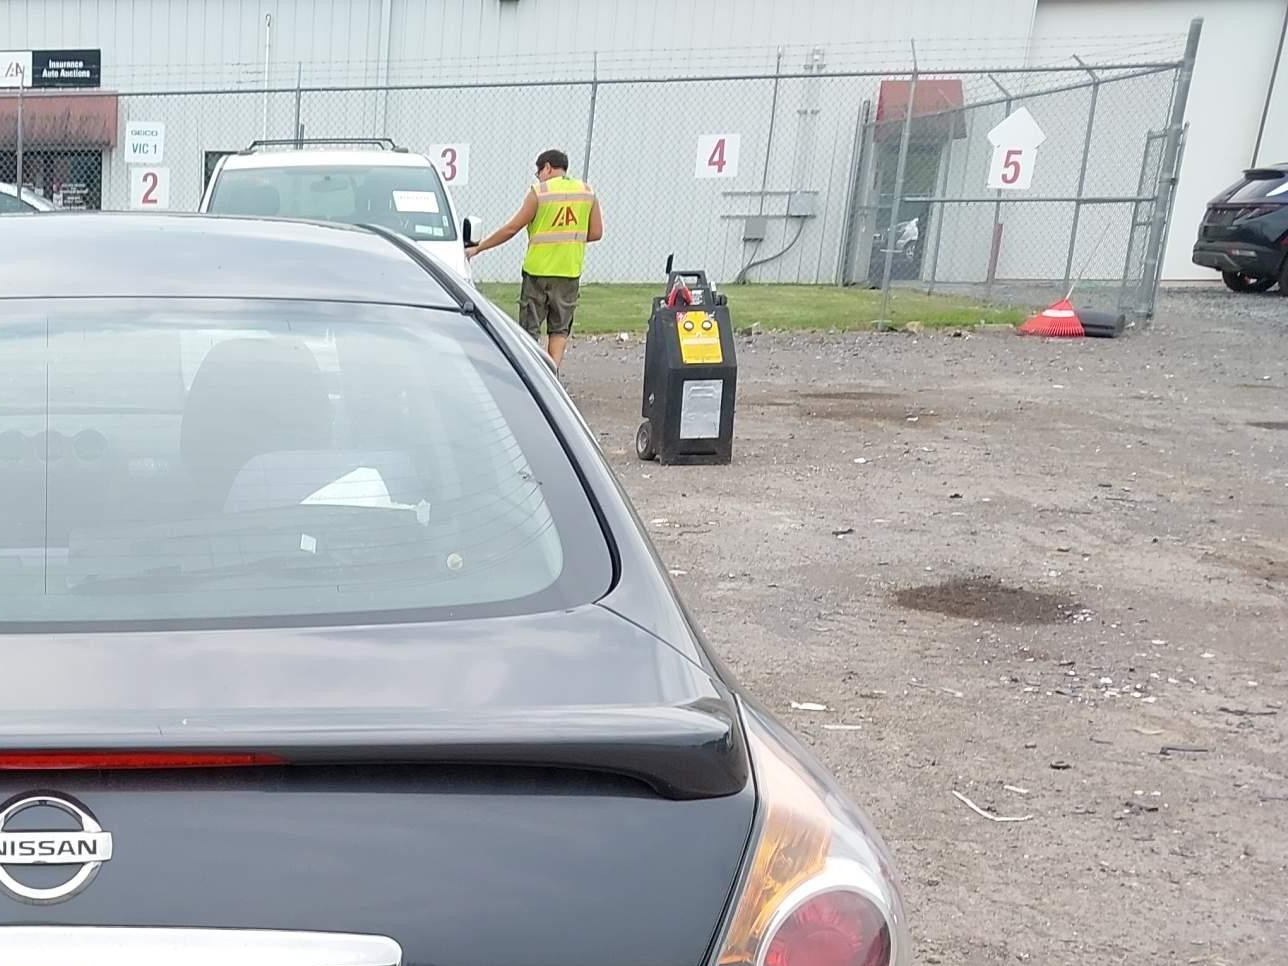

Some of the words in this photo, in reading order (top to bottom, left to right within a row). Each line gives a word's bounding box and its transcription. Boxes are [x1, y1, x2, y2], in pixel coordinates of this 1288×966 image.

[42, 68, 59, 78] Auto
[60, 68, 91, 78] Auctions
[48, 60, 84, 69] Insurance
[132, 143, 149, 154] VIC
[152, 143, 157, 154] 1
[441, 148, 457, 181] 3
[708, 138, 726, 173] 4
[1001, 150, 1022, 184] 5
[142, 172, 158, 204] 2
